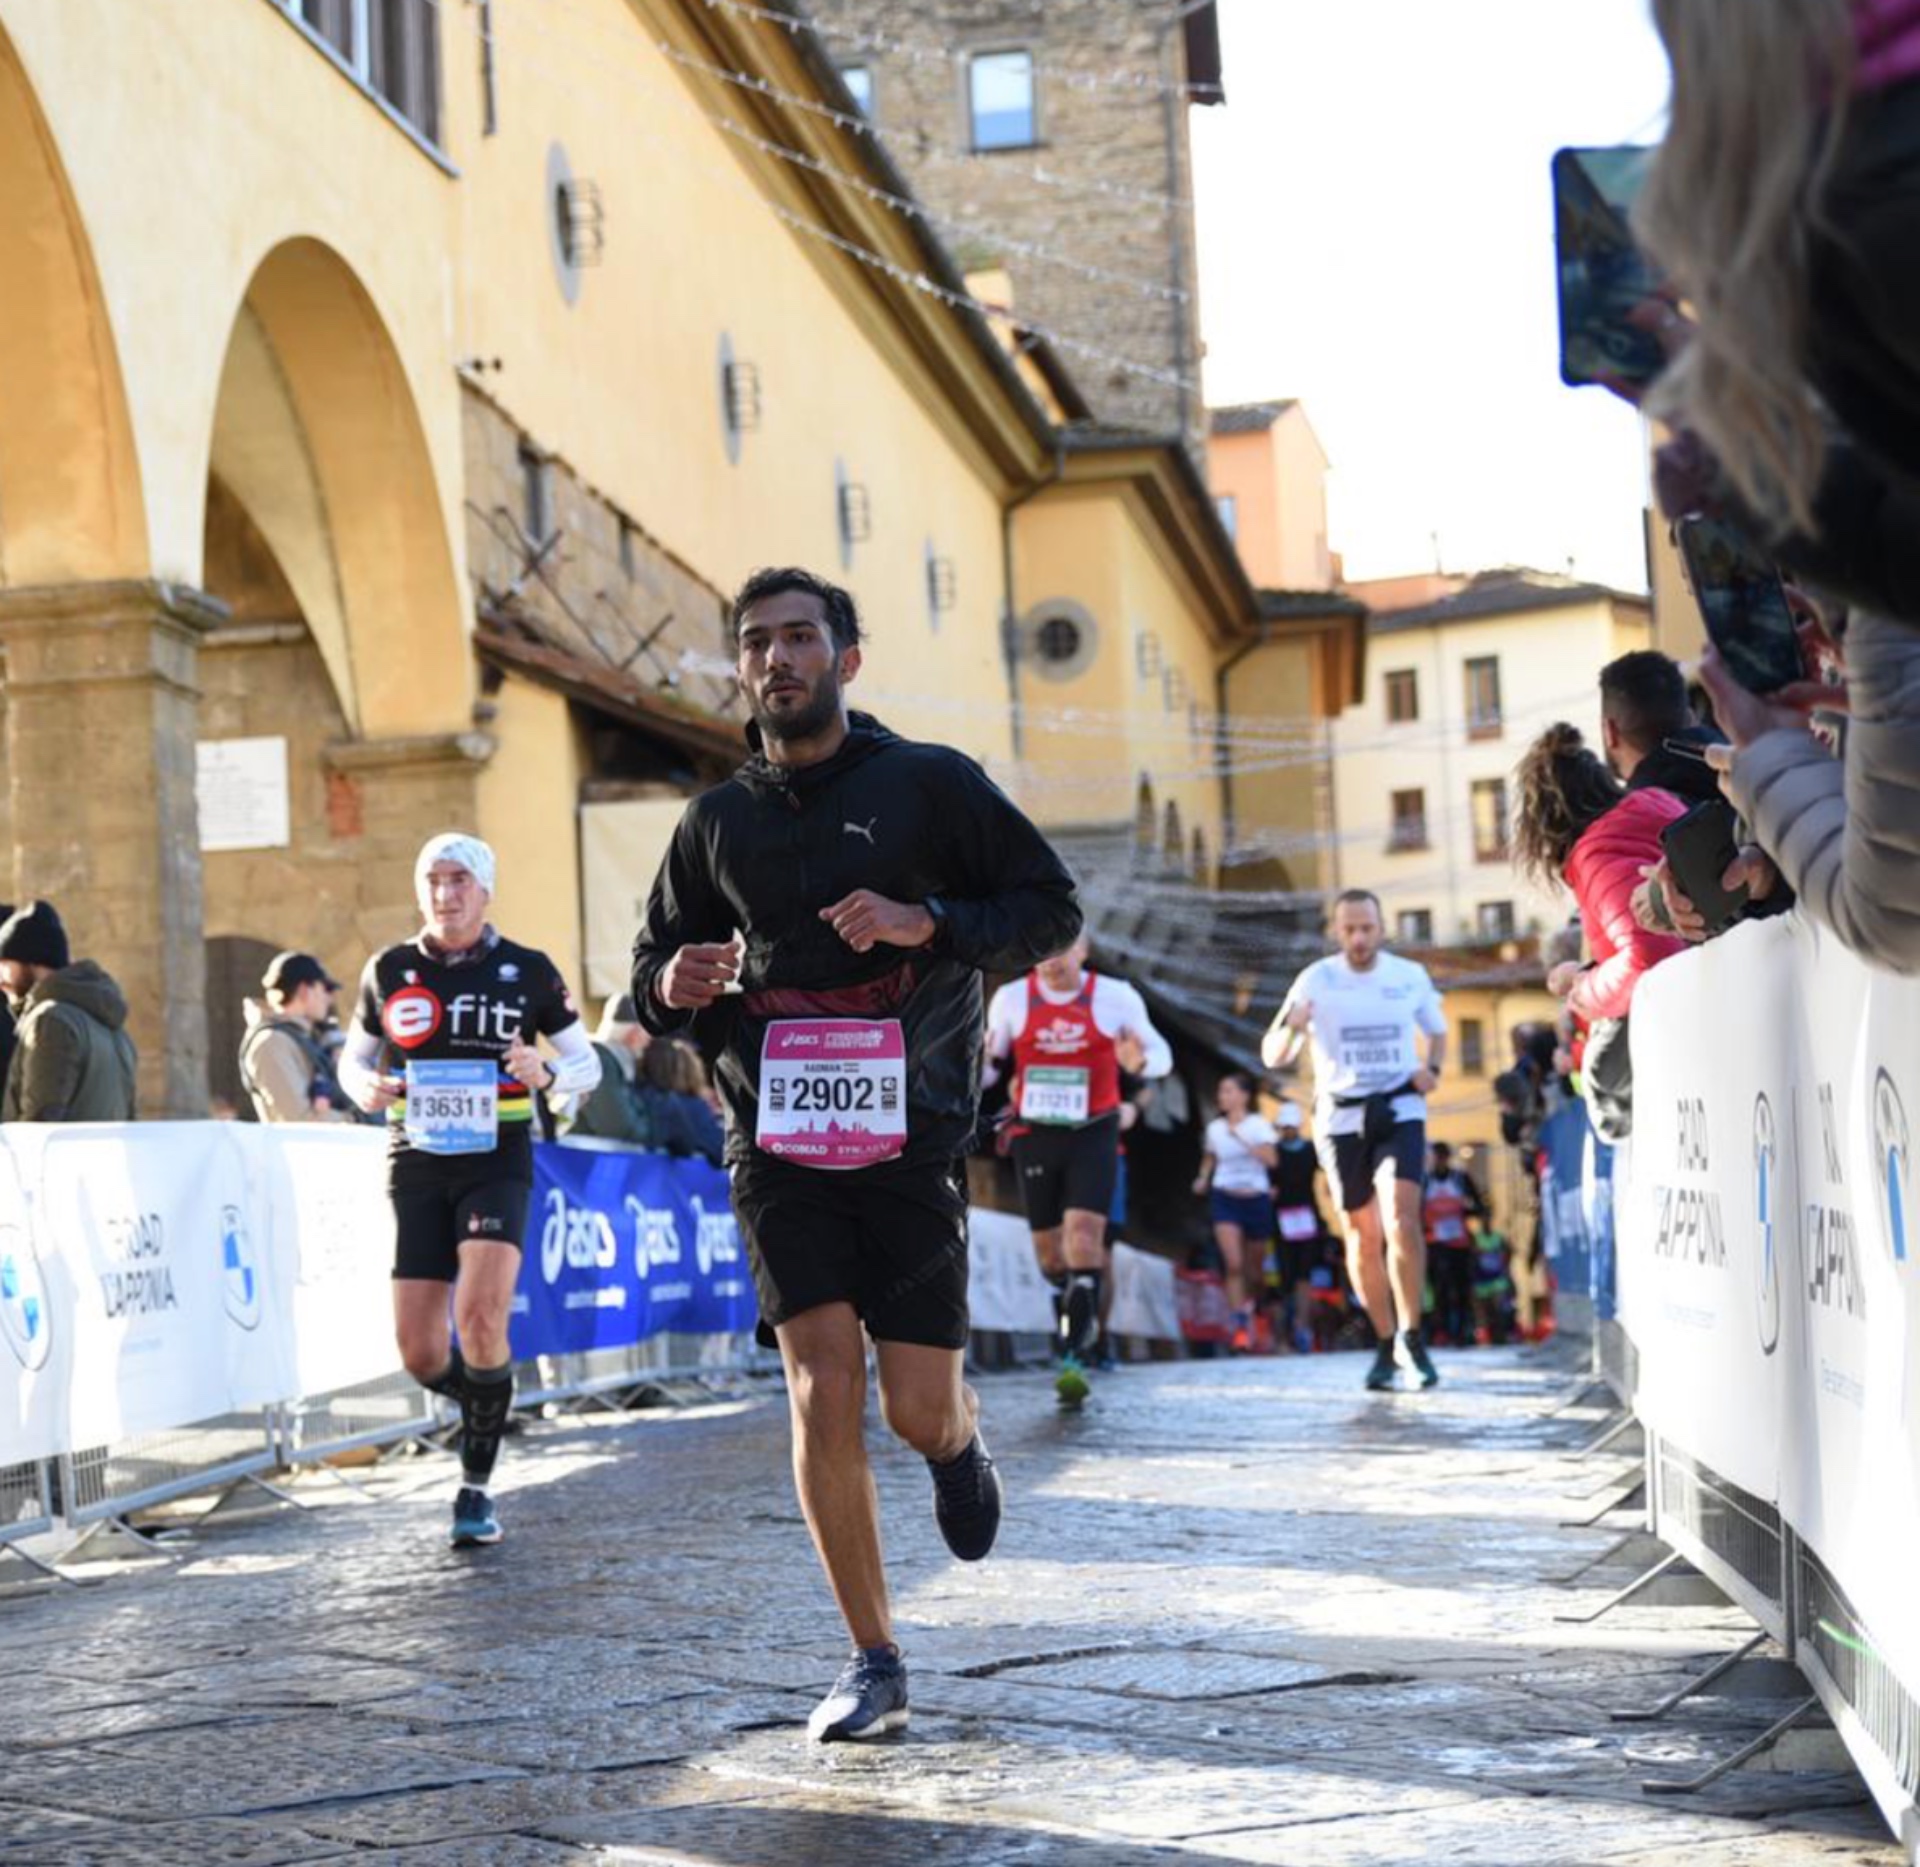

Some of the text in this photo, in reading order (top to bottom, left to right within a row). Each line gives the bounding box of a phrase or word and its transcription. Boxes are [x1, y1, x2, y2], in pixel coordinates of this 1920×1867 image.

[447, 994, 523, 1040] fit
[425, 1096, 474, 1118] 3631
[791, 1077, 874, 1111] 2902
